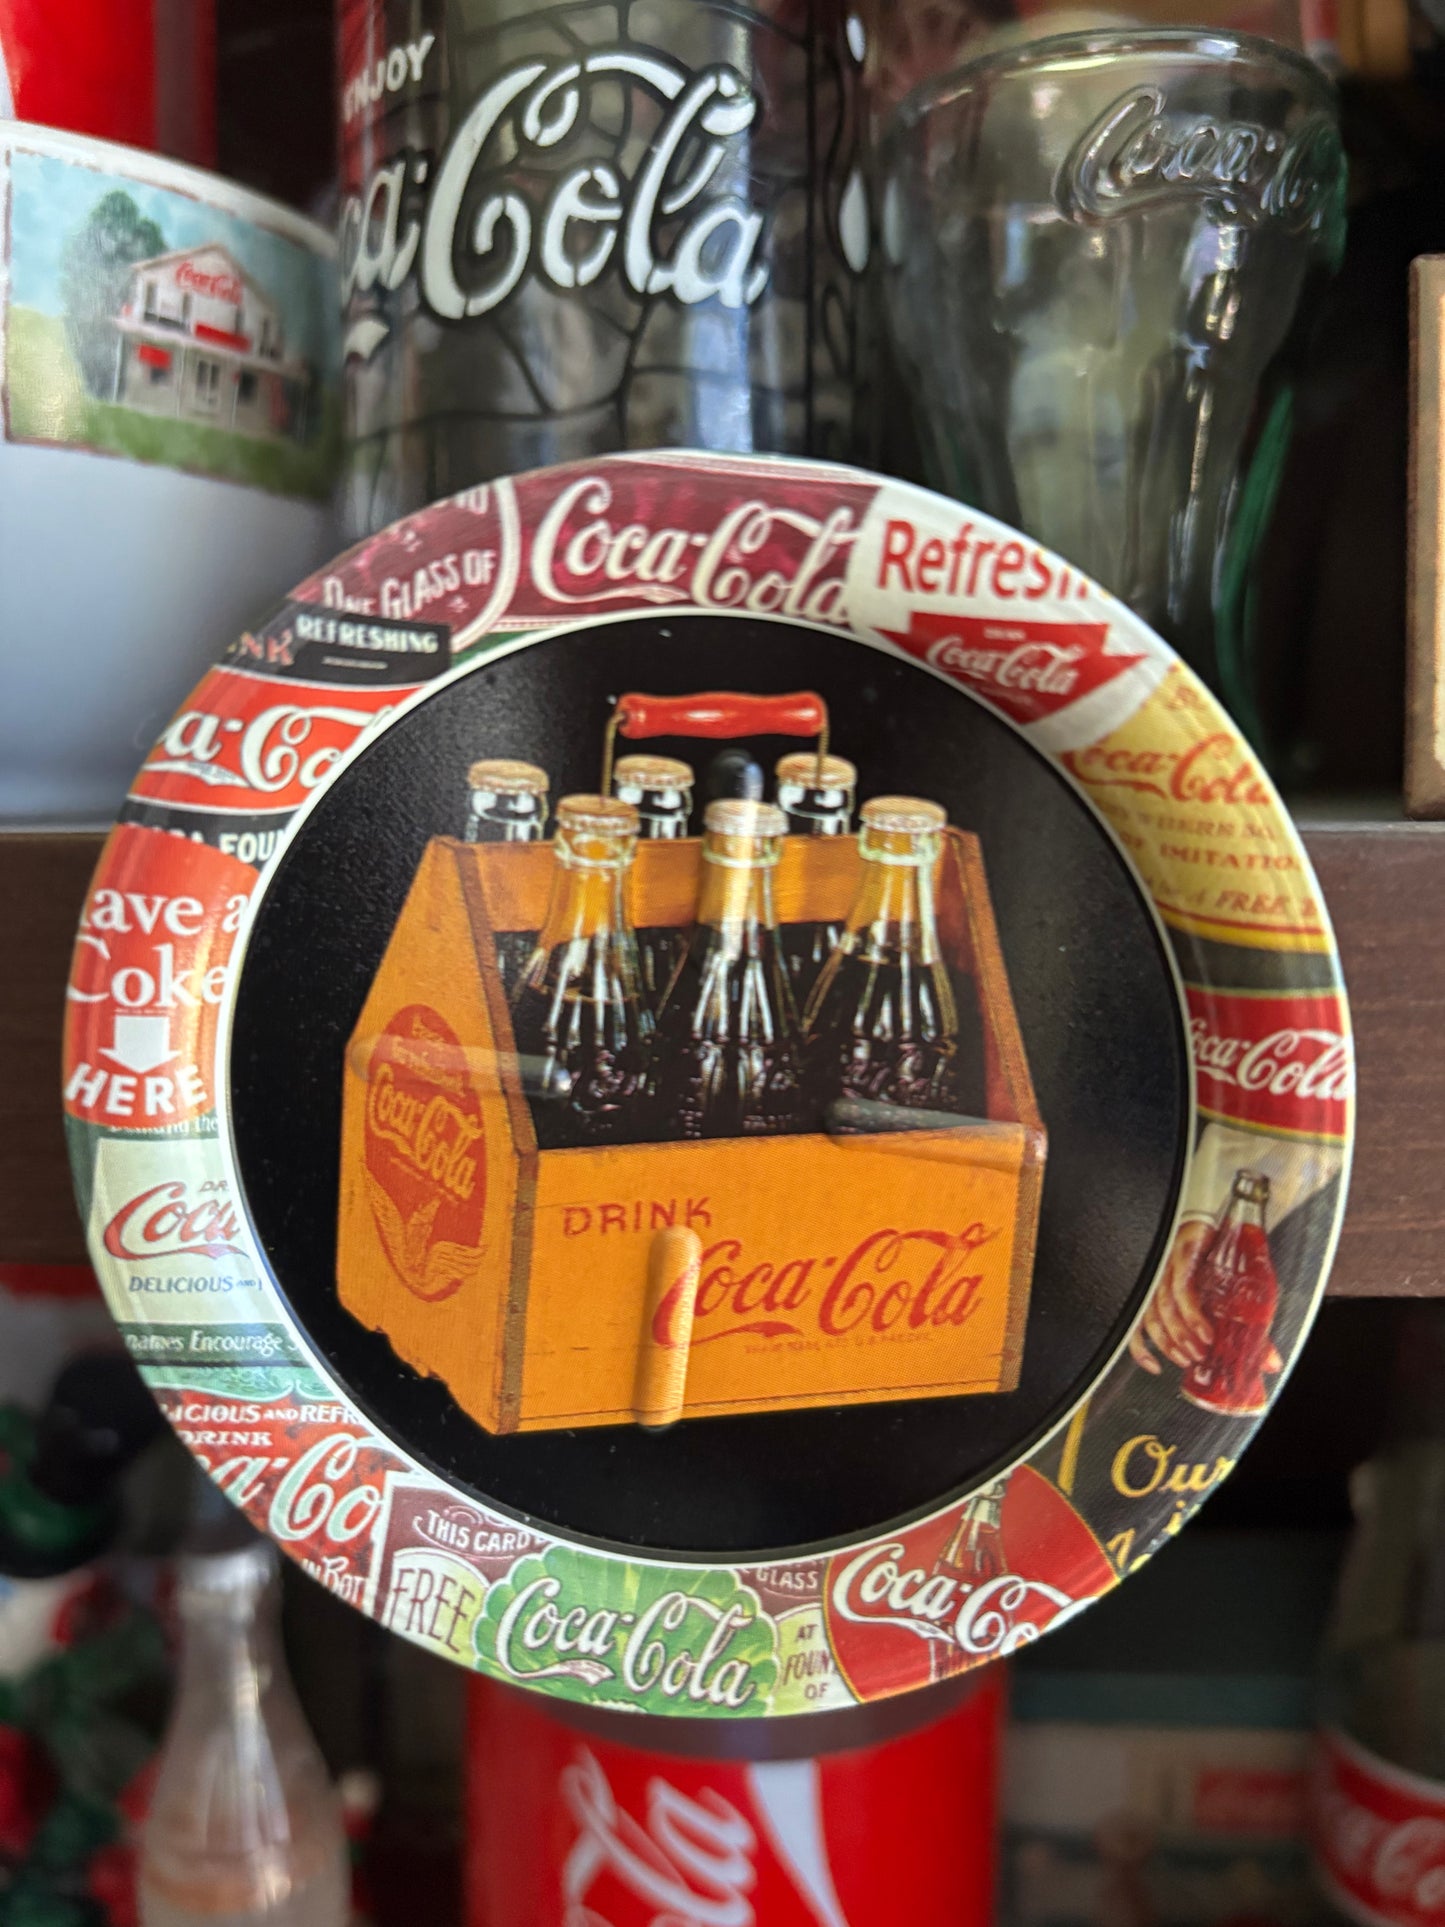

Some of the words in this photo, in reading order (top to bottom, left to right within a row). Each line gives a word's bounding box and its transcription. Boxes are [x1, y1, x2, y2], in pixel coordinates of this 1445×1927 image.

[531, 476, 866, 625] Coca-Cola
[380, 552, 461, 620] GLASS
[462, 549, 497, 587] OF
[296, 613, 440, 655] REFRESHING
[926, 635, 1086, 696] Coca-Cola
[80, 888, 205, 936] ave
[63, 1062, 208, 1117] HERE
[370, 1061, 484, 1202] Coca-Cola
[563, 1197, 713, 1236] DRINK
[129, 1275, 233, 1293] DELICIOUS
[652, 1221, 1000, 1349] Coca-Cola
[189, 1329, 284, 1358] Encourage
[263, 1407, 299, 1421] AND
[427, 1509, 471, 1550] THIS
[473, 1530, 532, 1553] CARD
[756, 1566, 819, 1590] GLASS
[391, 1567, 476, 1655] FREE
[795, 1623, 818, 1643] AT
[496, 1576, 756, 1708] Coca-Cola
[804, 1681, 830, 1700] OF
